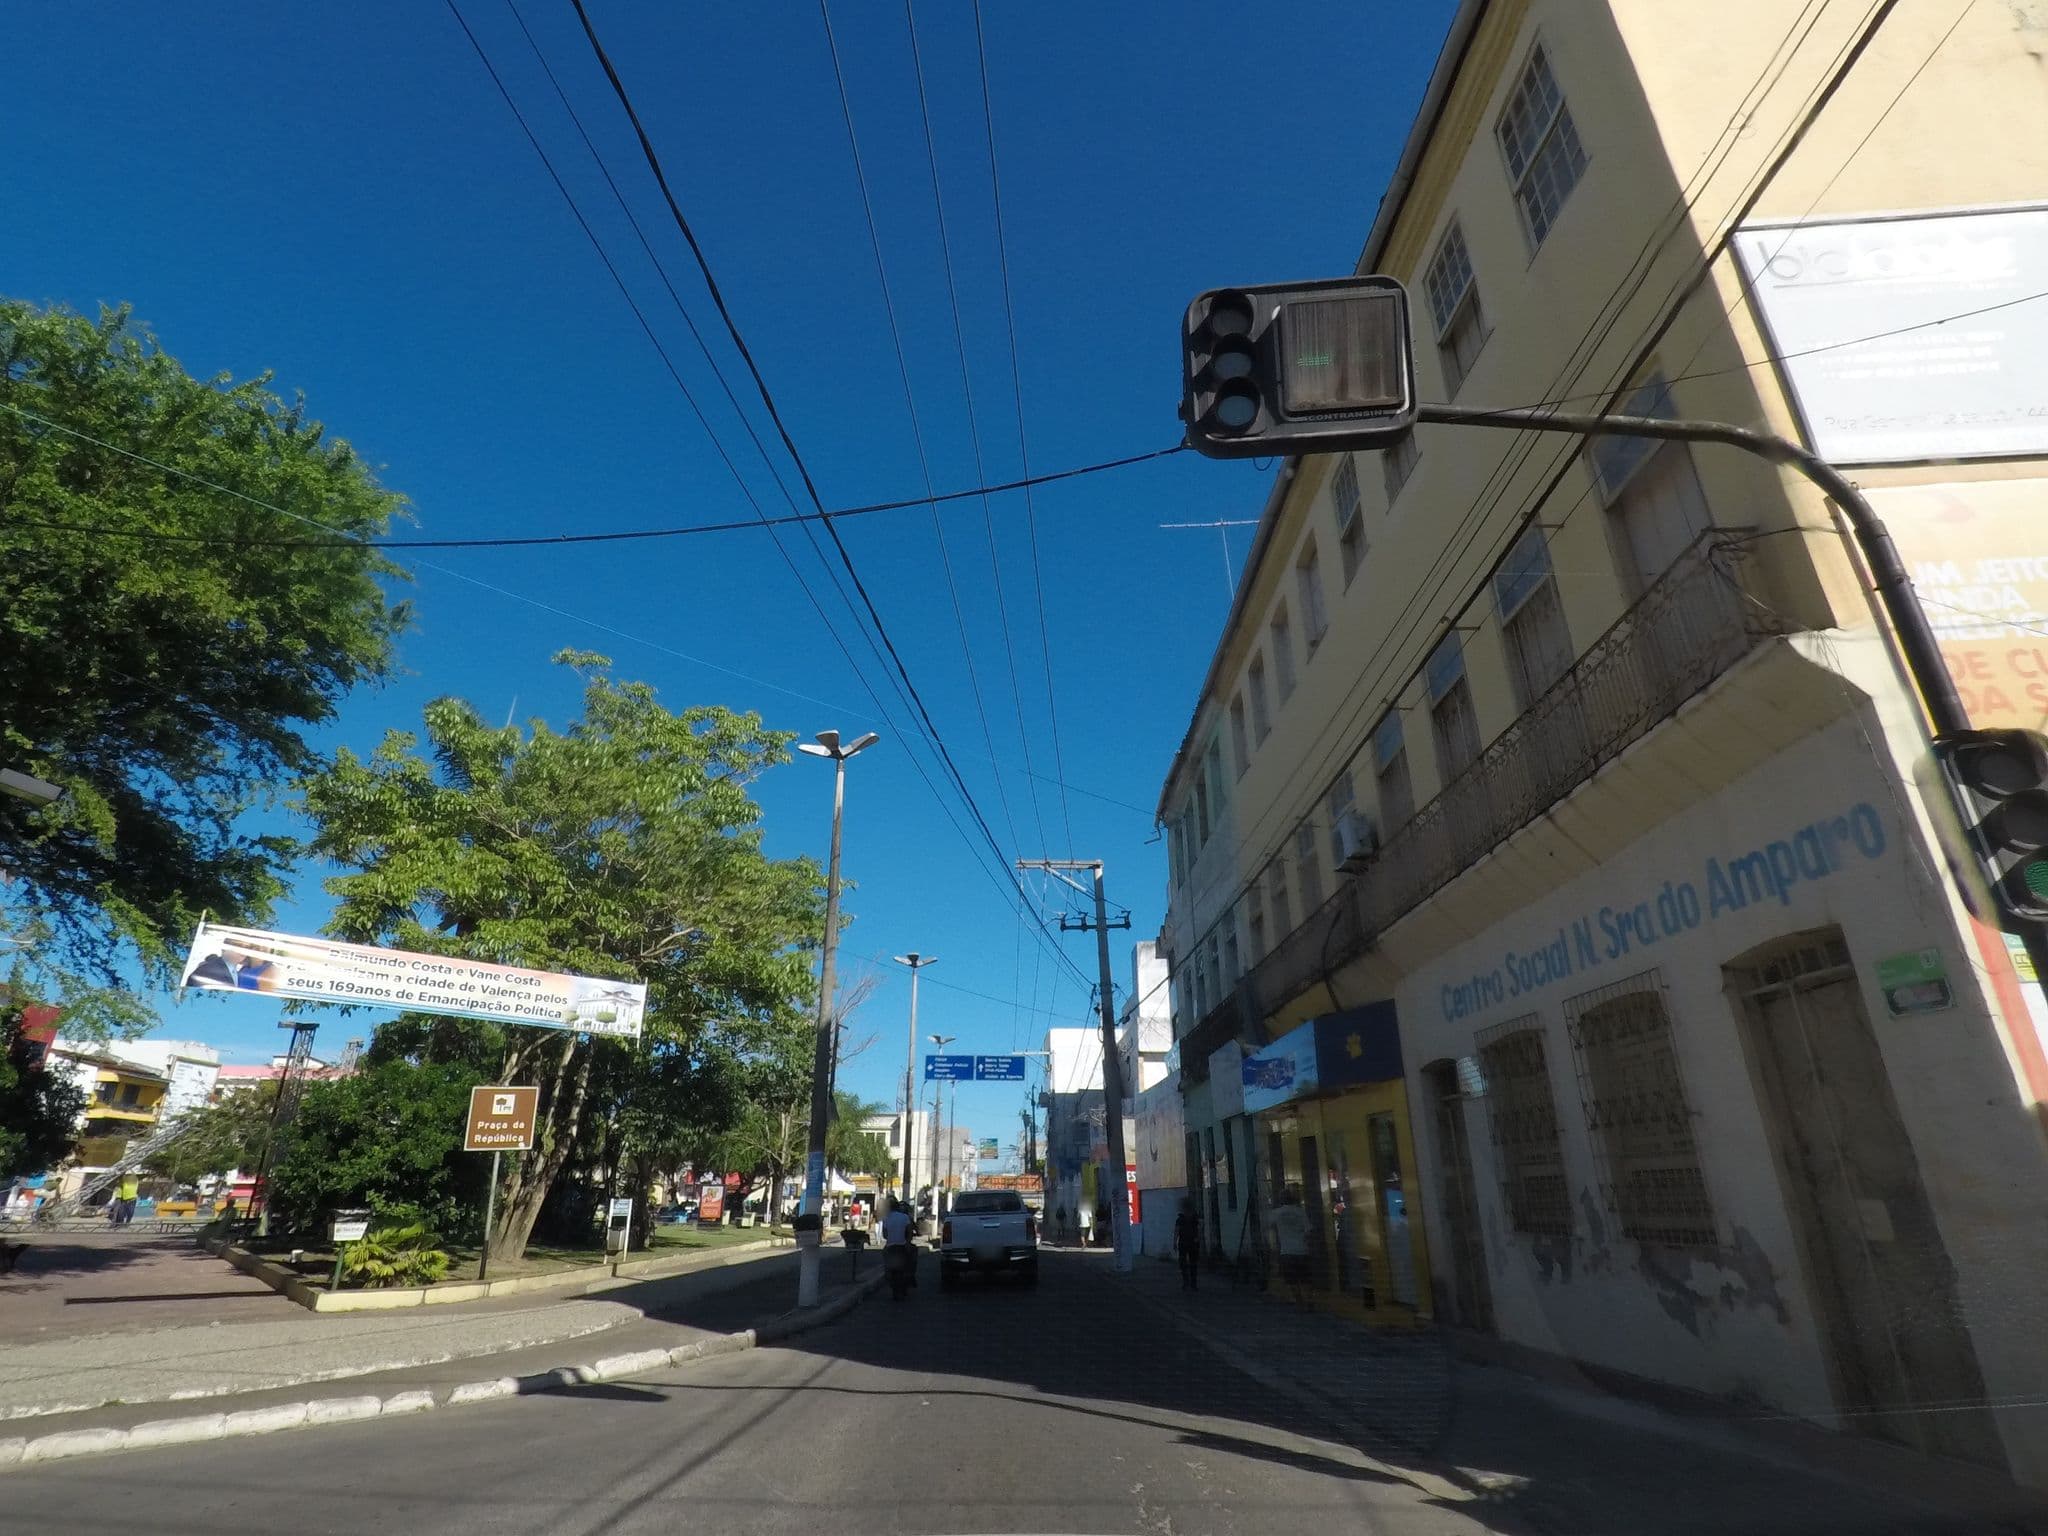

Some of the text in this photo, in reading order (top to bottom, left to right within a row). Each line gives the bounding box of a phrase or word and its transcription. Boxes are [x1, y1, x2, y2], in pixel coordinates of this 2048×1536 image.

[1439, 967, 1502, 1023] Centro
[1505, 928, 1572, 998] Social
[1658, 880, 1701, 936] do
[1704, 801, 1887, 919] Amparo
[411, 961, 452, 975] Costa
[456, 968, 465, 976] e
[469, 968, 501, 982] Vane
[505, 973, 541, 987] Costa
[287, 976, 323, 989] seus
[395, 988, 413, 1000] de
[418, 991, 511, 1013] Emancipação
[515, 1004, 562, 1019] Política
[394, 975, 568, 1005] a cidade de Valença pelos
[474, 1134, 524, 1144] República
[477, 1120, 525, 1131] Praça da
